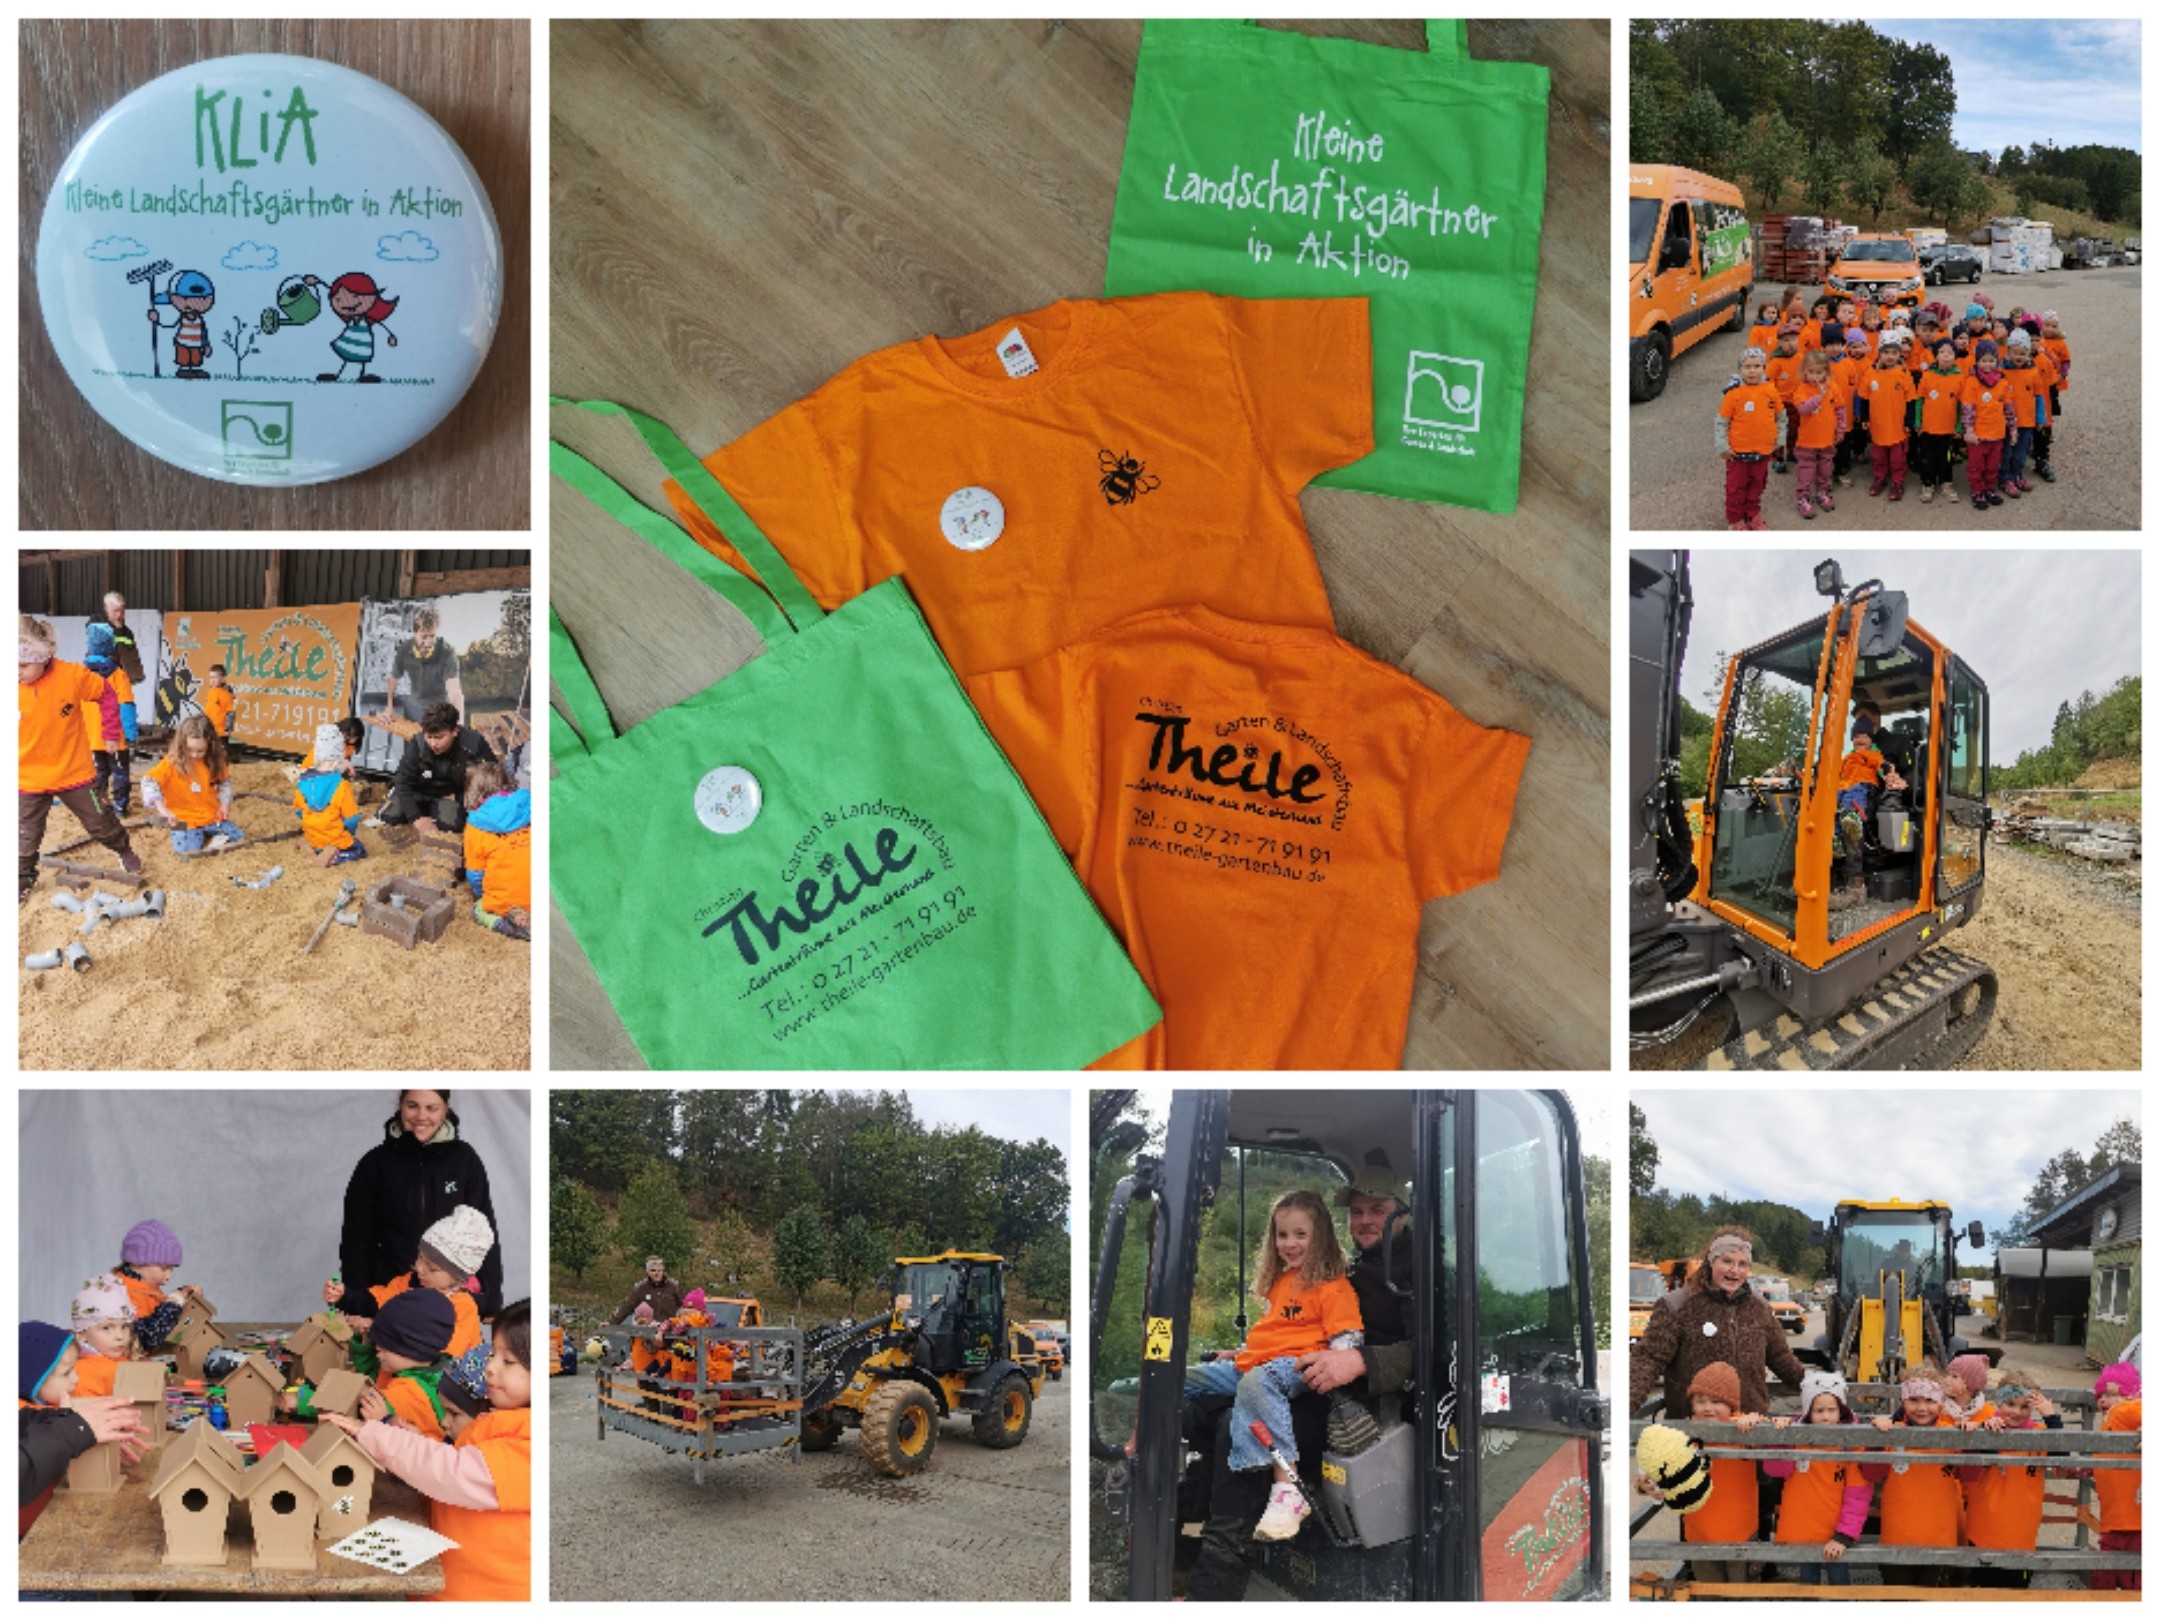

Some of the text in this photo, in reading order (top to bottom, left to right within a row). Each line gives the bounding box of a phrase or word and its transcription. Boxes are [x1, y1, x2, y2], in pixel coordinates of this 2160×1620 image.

[195, 84, 318, 172] KLiA
[1294, 110, 1385, 162] Kleine
[66, 178, 462, 225] Kleine Landschaftsgärtner in Aktion
[1164, 160, 1498, 238] Landschaftsgärtner
[1248, 226, 1410, 279] in Aktion
[215, 633, 329, 682] Theile
[1135, 712, 1326, 803] Theile
[1216, 717, 1353, 831] Garten & Landschaftsbau
[782, 798, 955, 882] Garten & Landschaftsbau
[1193, 824, 1216, 843] 27
[1220, 830, 1240, 845] 21
[1257, 837, 1277, 854] 71
[1282, 842, 1302, 859] 91
[1310, 847, 1330, 865] 91
[701, 828, 917, 965] Theile
[831, 955, 853, 979] 27
[858, 940, 878, 961] 21
[893, 919, 915, 939] 71
[918, 902, 940, 924] 91
[943, 885, 966, 909] 91
